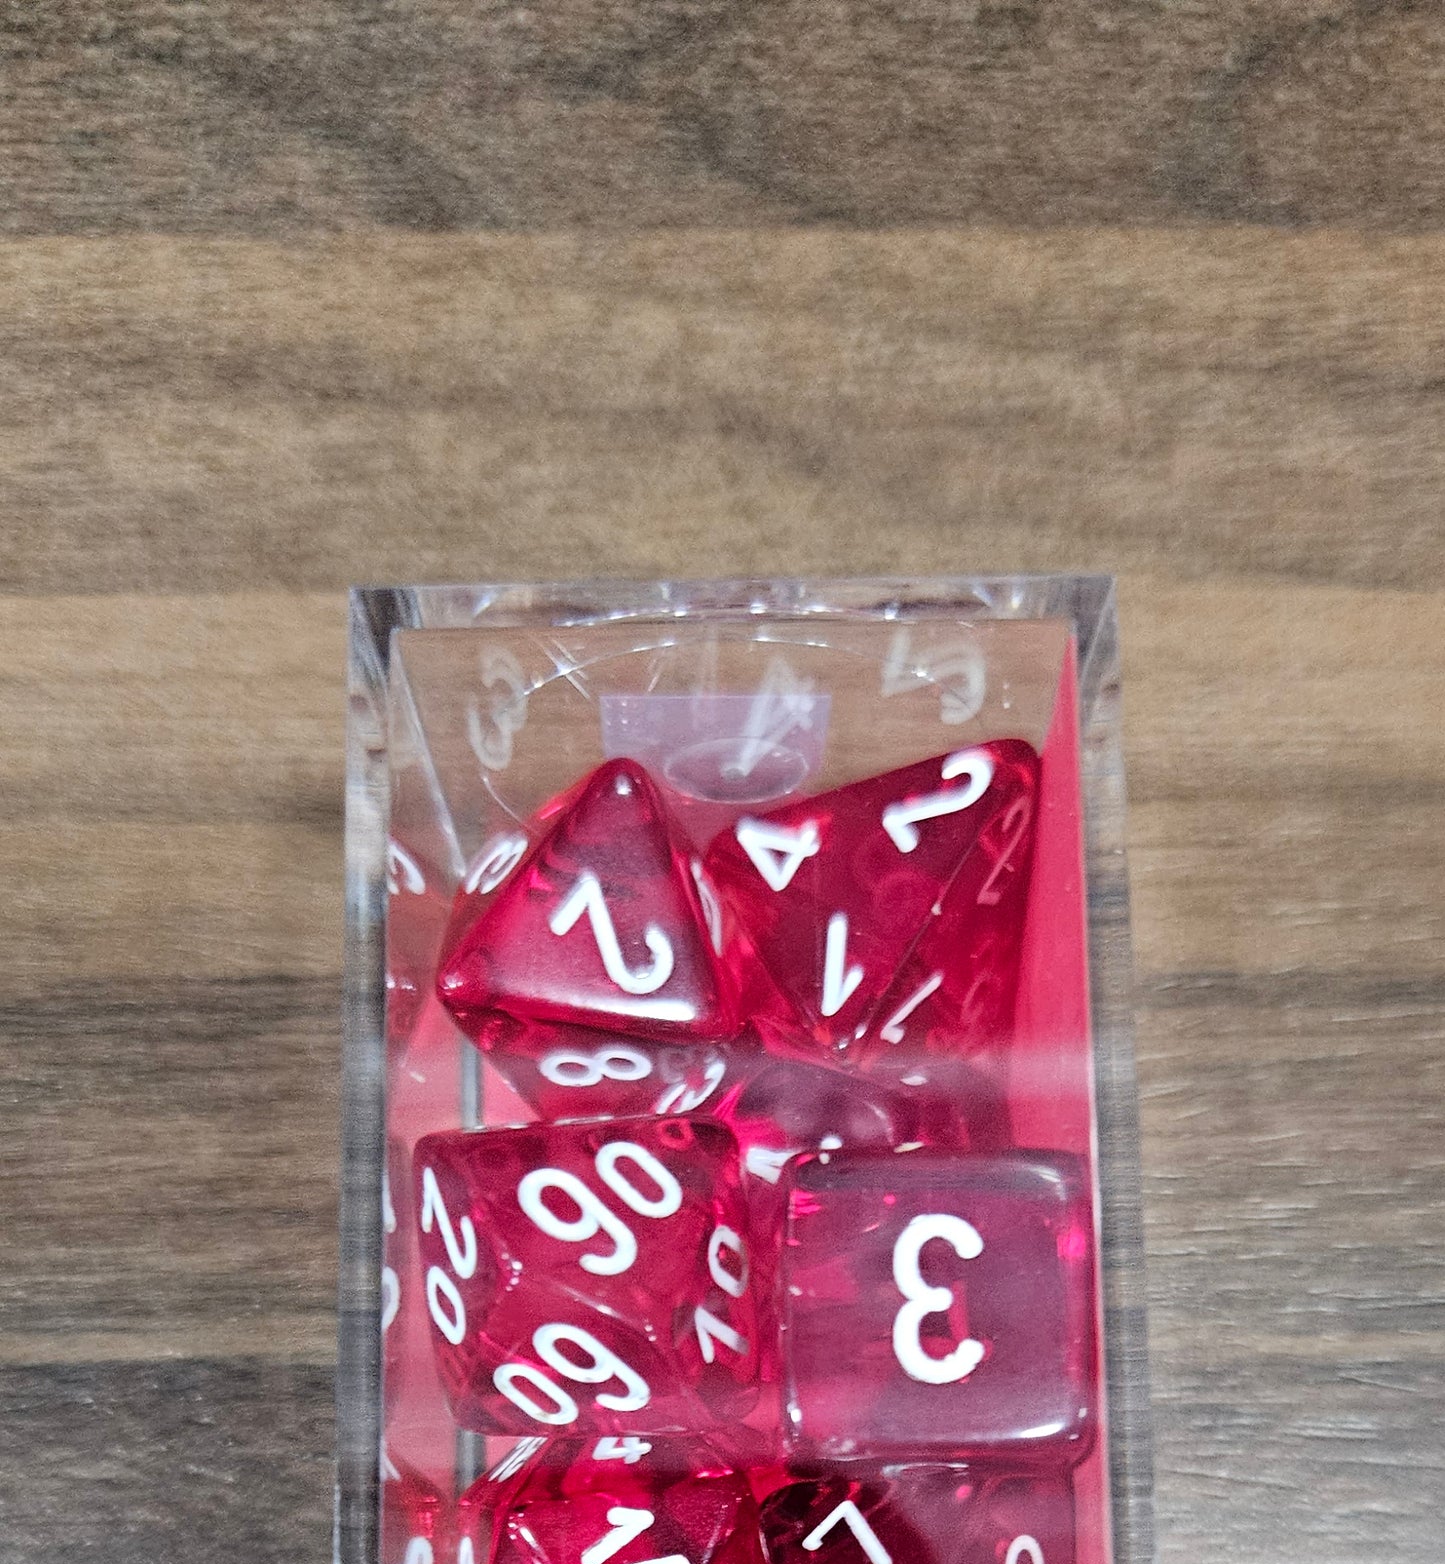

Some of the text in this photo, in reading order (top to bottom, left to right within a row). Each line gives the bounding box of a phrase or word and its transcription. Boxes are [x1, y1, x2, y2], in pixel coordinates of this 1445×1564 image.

[737, 817, 820, 891] 4
[884, 748, 993, 853] 2
[548, 870, 674, 995] 2
[821, 913, 863, 1016] 1
[538, 1046, 653, 1087] 8
[421, 1167, 477, 1344] 20
[517, 1141, 683, 1276] 90
[893, 1213, 985, 1384] 3
